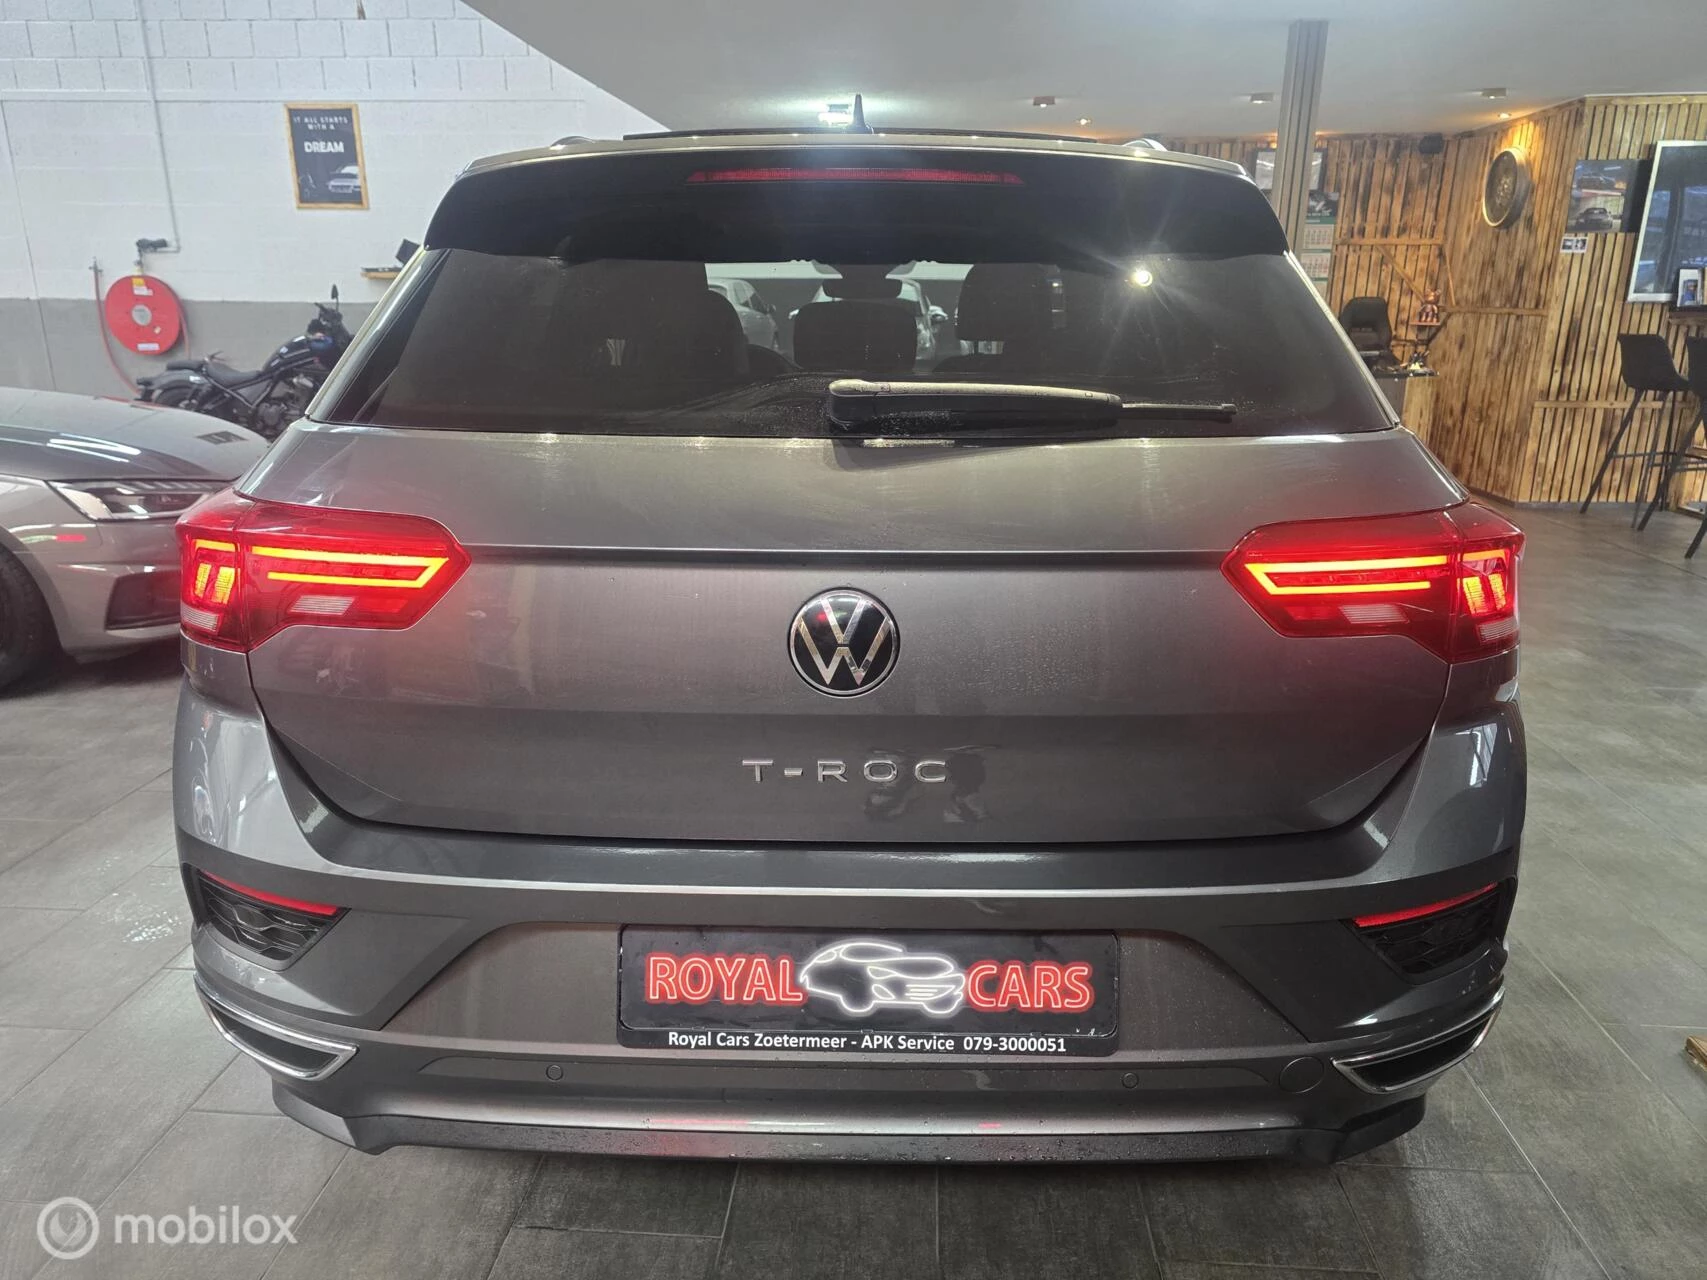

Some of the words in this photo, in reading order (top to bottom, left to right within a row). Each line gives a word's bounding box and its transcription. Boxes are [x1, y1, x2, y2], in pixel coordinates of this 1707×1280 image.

[304, 116, 318, 124] ALL
[320, 116, 348, 124] STARTS
[304, 141, 344, 152] DREAM
[742, 760, 947, 782] T-ROC
[648, 955, 805, 1003] ROYAL
[967, 963, 1093, 1010] CARS
[668, 1031, 712, 1048] Royal
[716, 1032, 750, 1047] Cars
[754, 1033, 848, 1048] Zoetermeer
[861, 1035, 894, 1050] APK
[897, 1035, 955, 1050] Service
[963, 1036, 1067, 1052] 079-3000051
